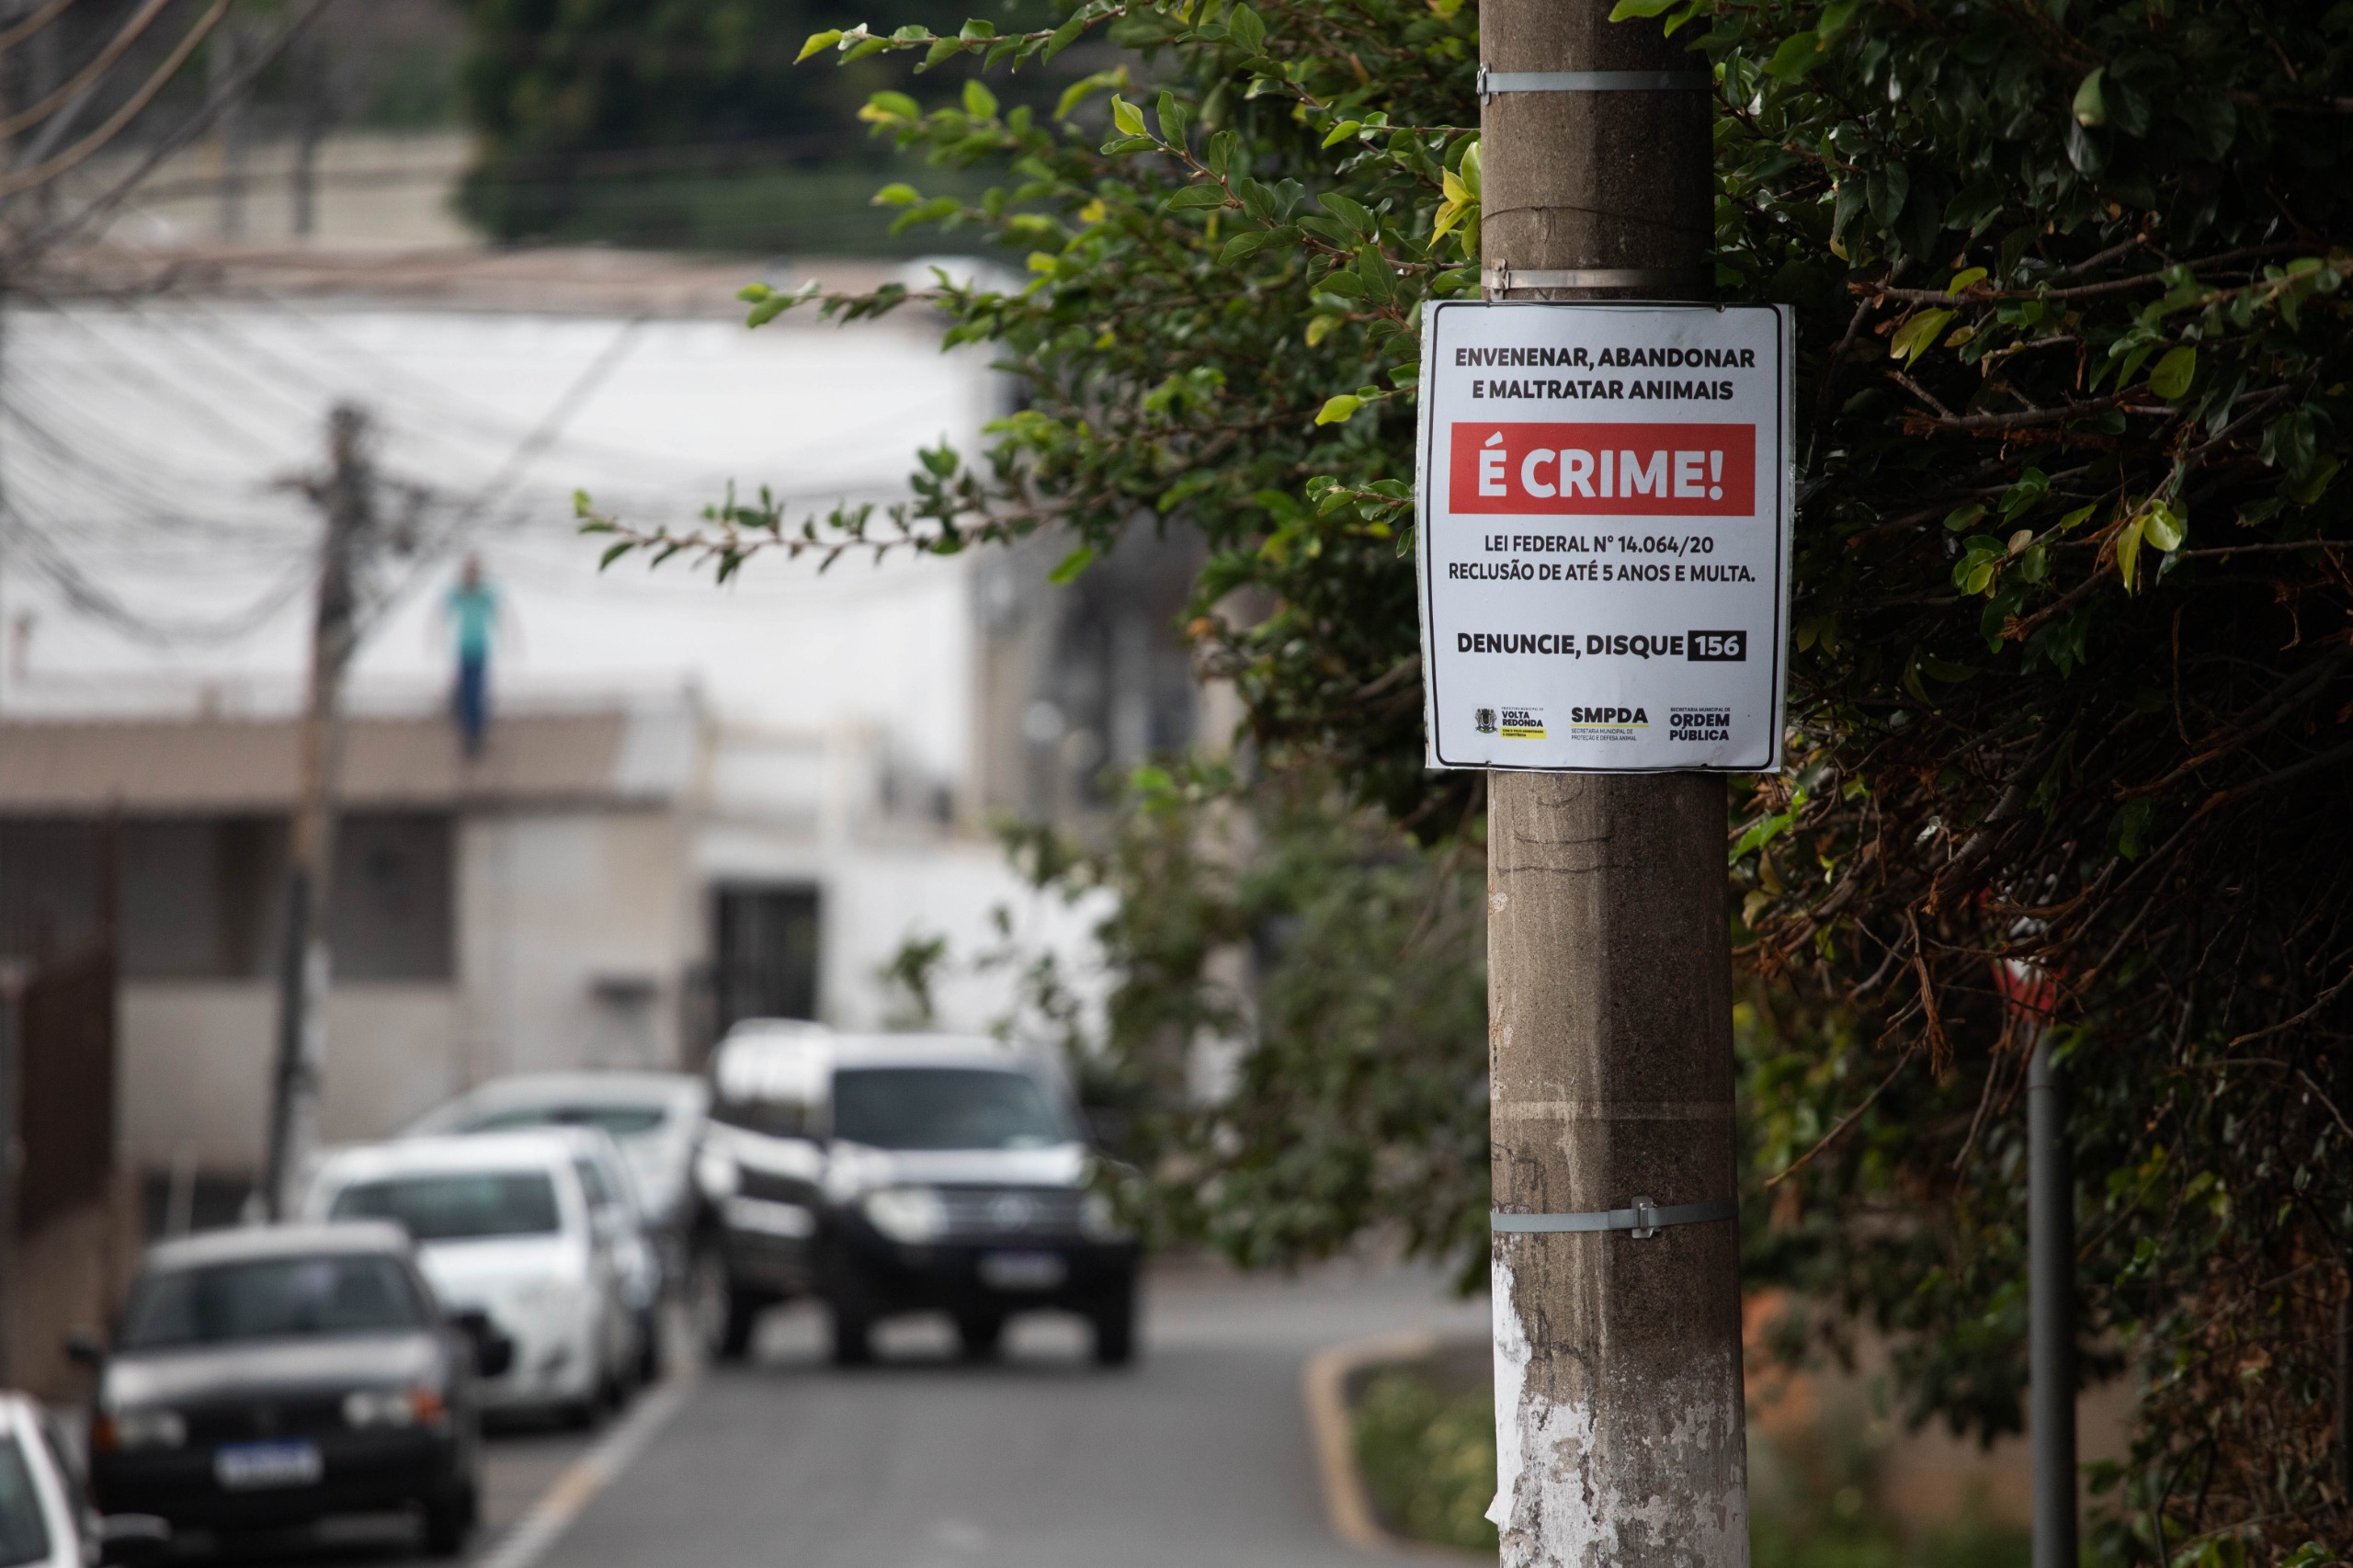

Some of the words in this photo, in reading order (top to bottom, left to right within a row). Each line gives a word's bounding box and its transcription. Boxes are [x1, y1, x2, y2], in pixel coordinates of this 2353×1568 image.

[1455, 347, 1595, 371] ENVENENAR,
[1598, 348, 1755, 368] ABANDONAR
[1472, 381, 1483, 398] E
[1490, 380, 1623, 399] MALTRATAR
[1630, 381, 1733, 400] ANIMAIS
[1479, 431, 1506, 497] É
[1521, 448, 1724, 500] CRIME!
[1485, 536, 1508, 551] LEI
[1513, 536, 1589, 552] FEDERAL
[1618, 536, 1713, 555] 14.064/20
[1449, 559, 1534, 580] RECLUSÃO
[1540, 564, 1563, 580] DE
[1566, 560, 1597, 581] ATÉ
[1603, 565, 1612, 581] 5
[1618, 564, 1669, 582] ANOS
[1676, 565, 1685, 582] E
[1691, 565, 1756, 582] MULTA.
[1458, 632, 1581, 659] DENUNCIE,
[1587, 634, 1684, 661] DISQUE
[1694, 636, 1741, 656] 156
[1572, 707, 1648, 723] SMPDA
[1670, 714, 1730, 726] ORDEM
[1670, 724, 1729, 741] PÚBLICA
